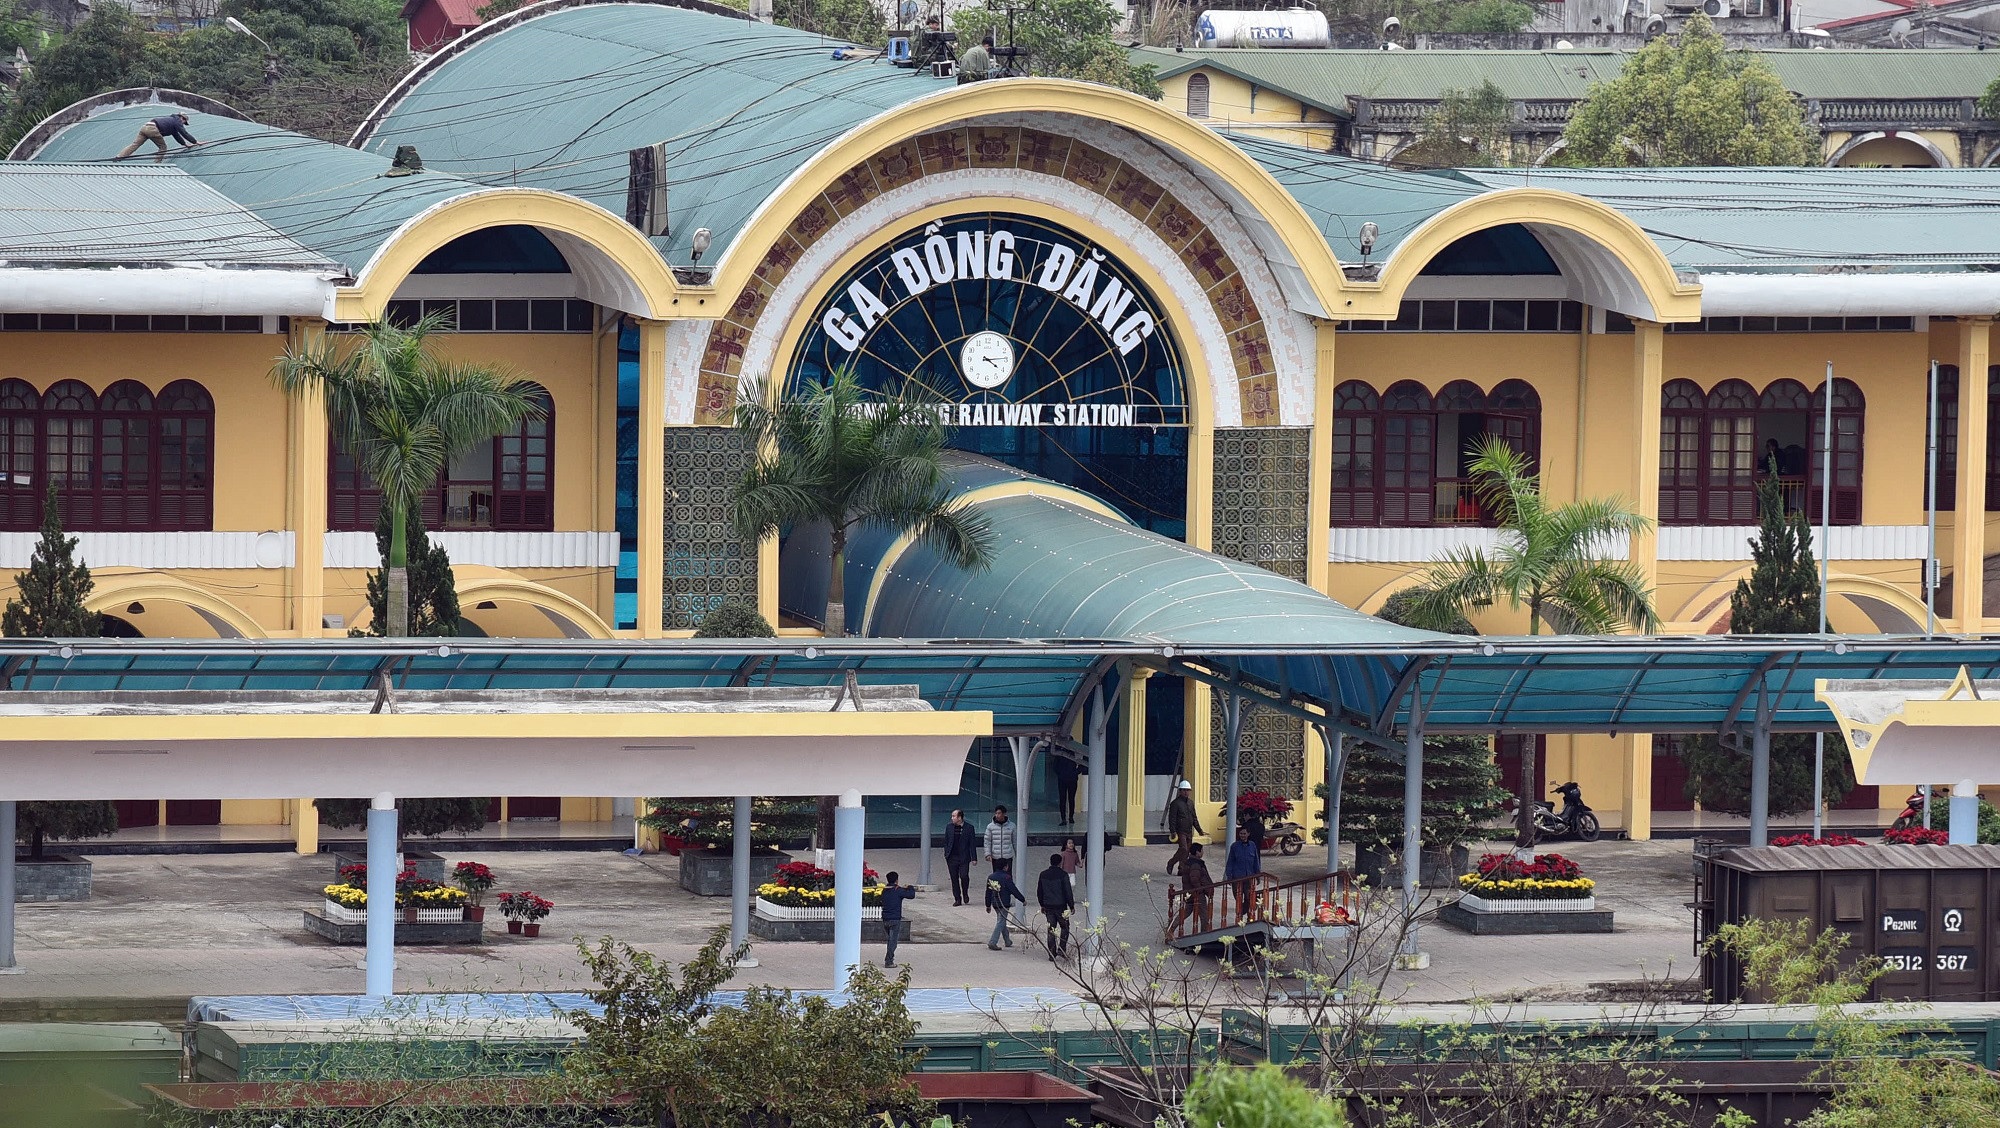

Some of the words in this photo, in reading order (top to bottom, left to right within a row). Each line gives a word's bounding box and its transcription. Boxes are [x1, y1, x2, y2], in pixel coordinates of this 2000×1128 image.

[822, 279, 890, 353] GA
[891, 219, 1016, 297] ĐỒNG
[1037, 246, 1155, 357] ĐĂNG
[959, 403, 1043, 426] RAILWAY
[1054, 403, 1133, 426] STATION
[1883, 916, 1917, 931] P62NK
[1883, 955, 1923, 970] 3312
[1936, 955, 1968, 970] 367
